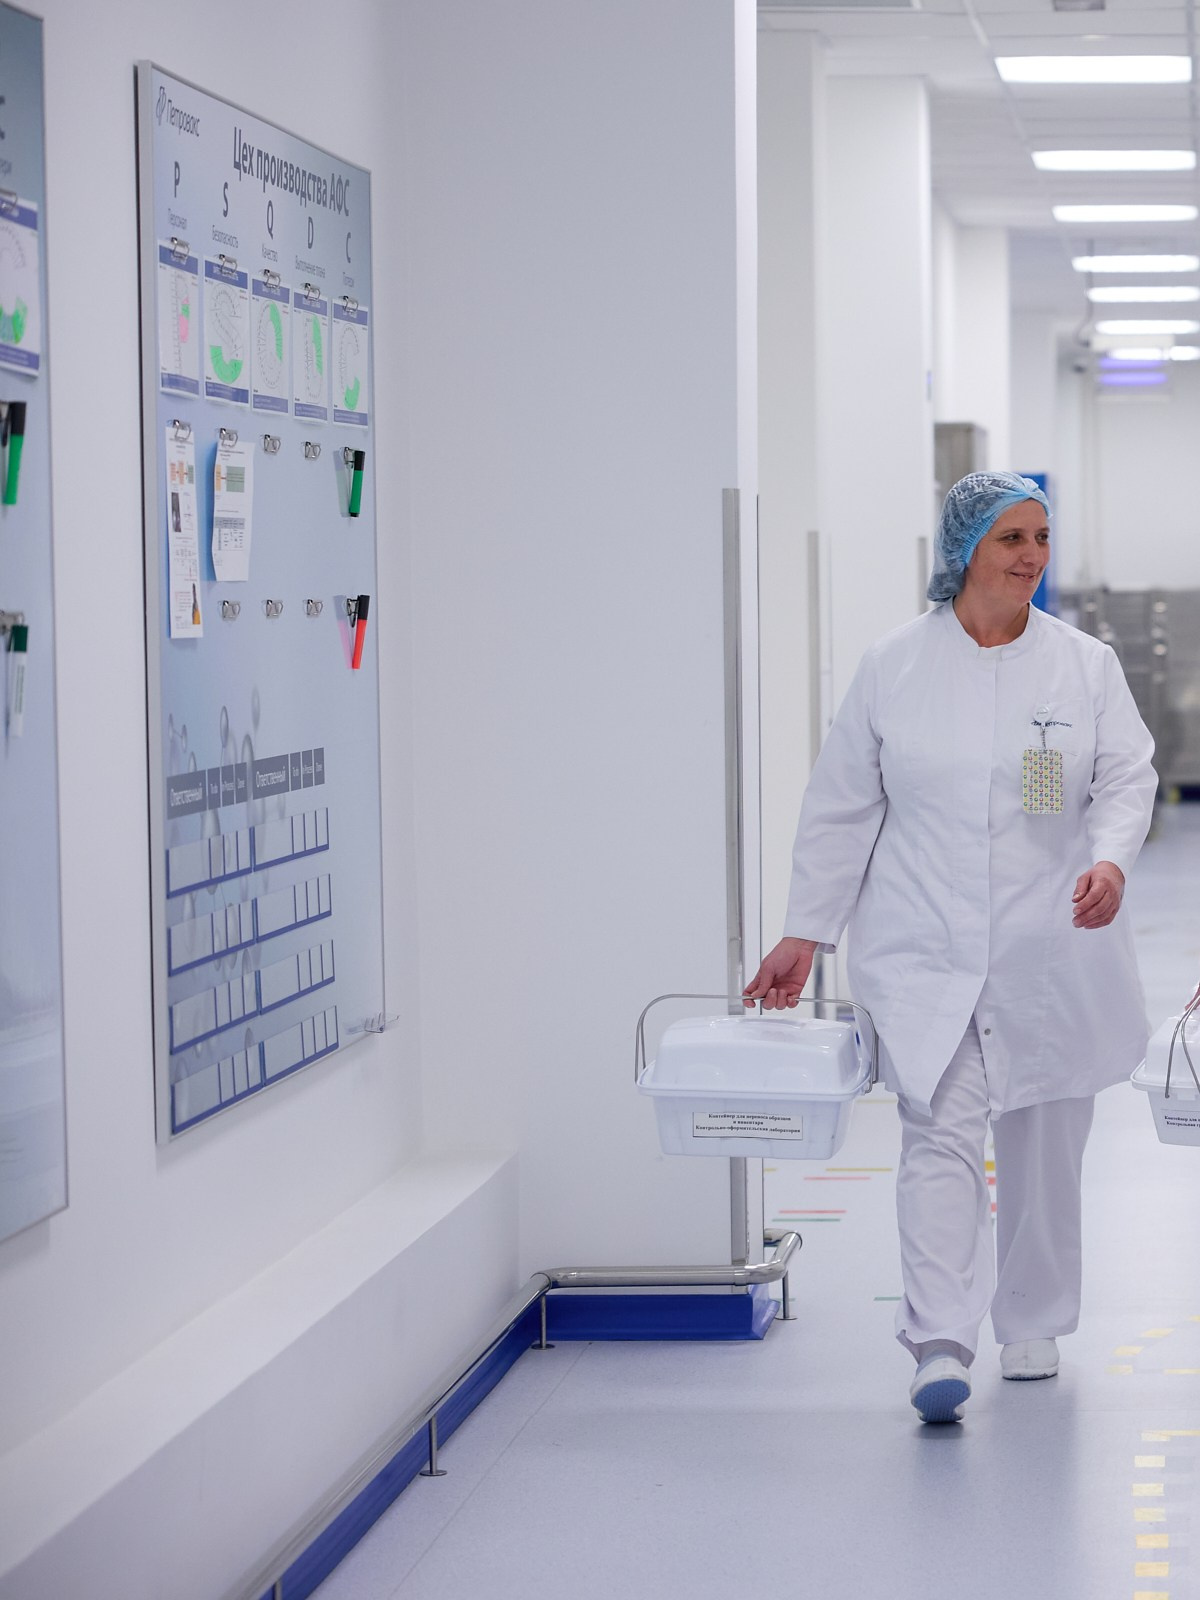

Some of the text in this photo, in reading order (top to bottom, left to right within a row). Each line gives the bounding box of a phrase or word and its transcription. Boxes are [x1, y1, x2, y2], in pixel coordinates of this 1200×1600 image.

[167, 99, 200, 137] Петровакс
[174, 161, 180, 198] P
[233, 126, 349, 216] Цех производства АФС
[223, 181, 229, 218] S
[266, 200, 274, 240] Q
[308, 216, 314, 250] D
[346, 232, 351, 263] C
[170, 781, 203, 808] Ответственный
[256, 766, 286, 788] Ответственный
